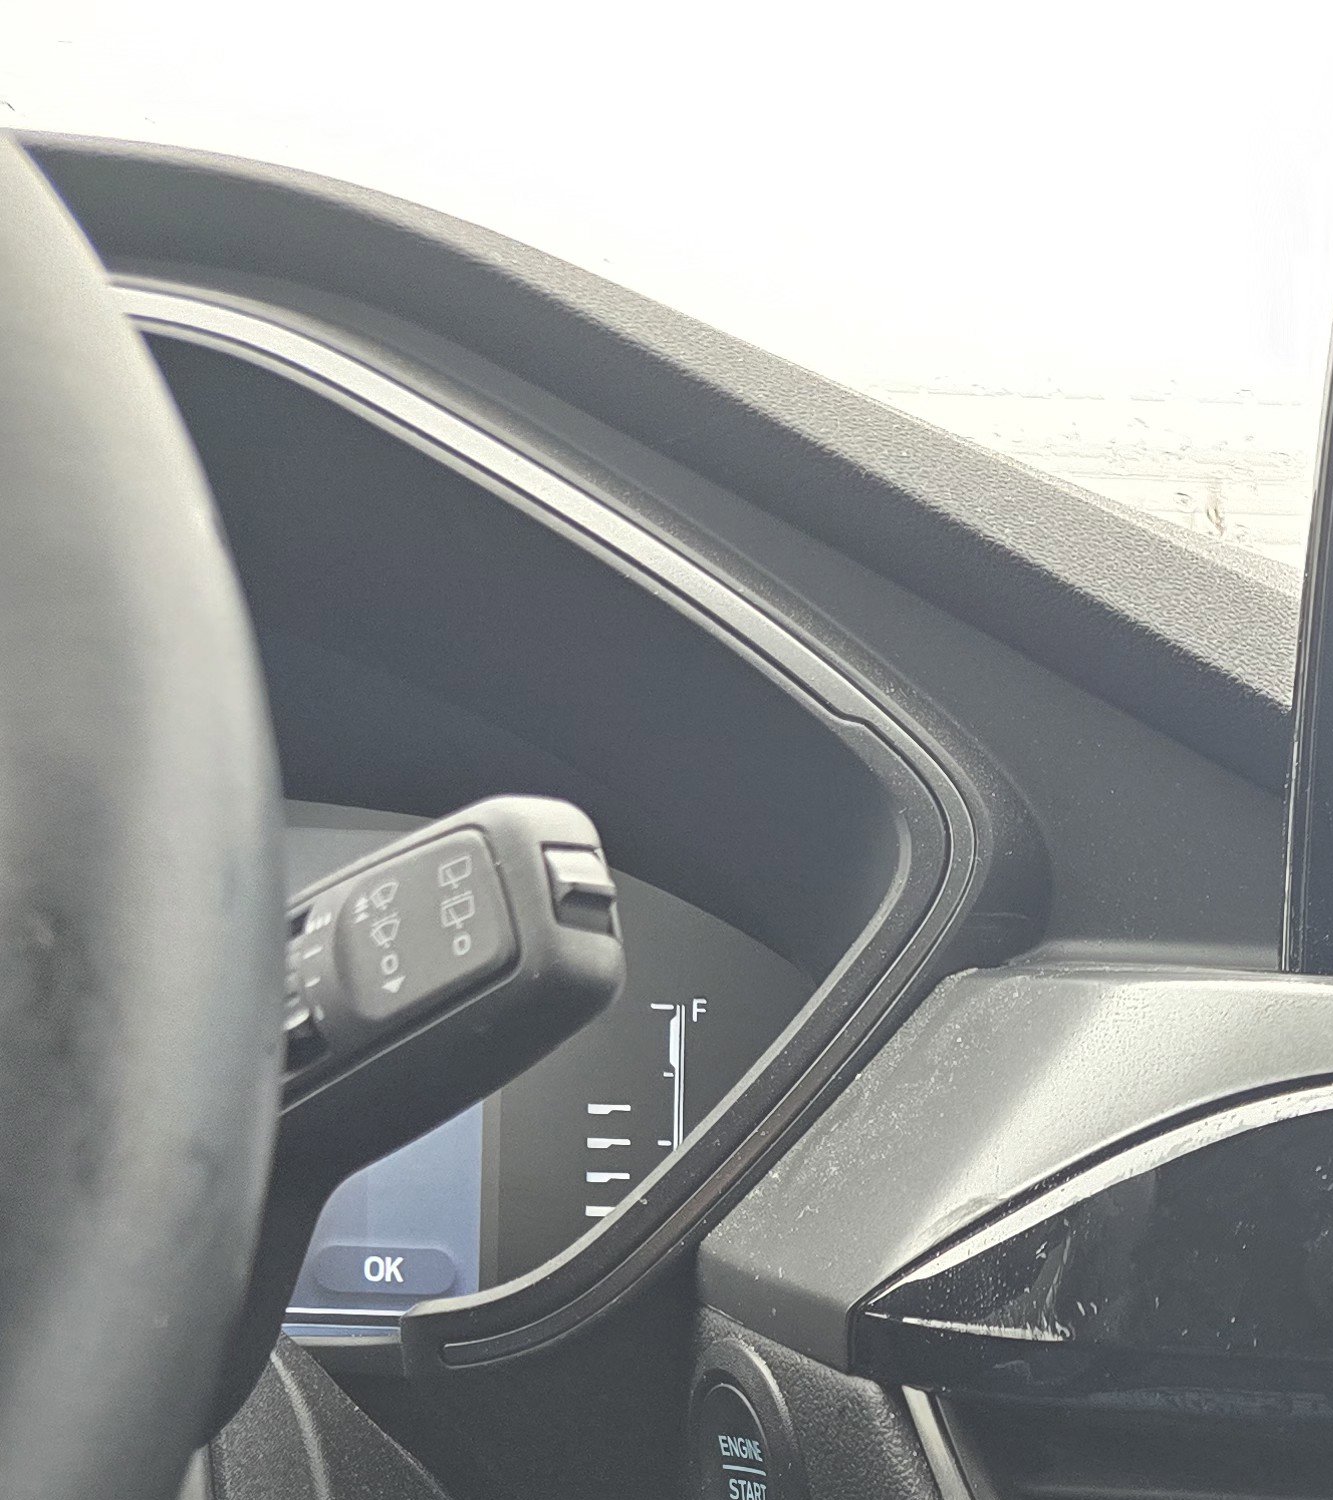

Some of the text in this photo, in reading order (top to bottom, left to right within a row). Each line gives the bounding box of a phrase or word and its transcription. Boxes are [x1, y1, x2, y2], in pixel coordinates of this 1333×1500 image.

[692, 998, 708, 1022] F
[363, 1256, 404, 1283] OK
[718, 1434, 764, 1462] ENGINE
